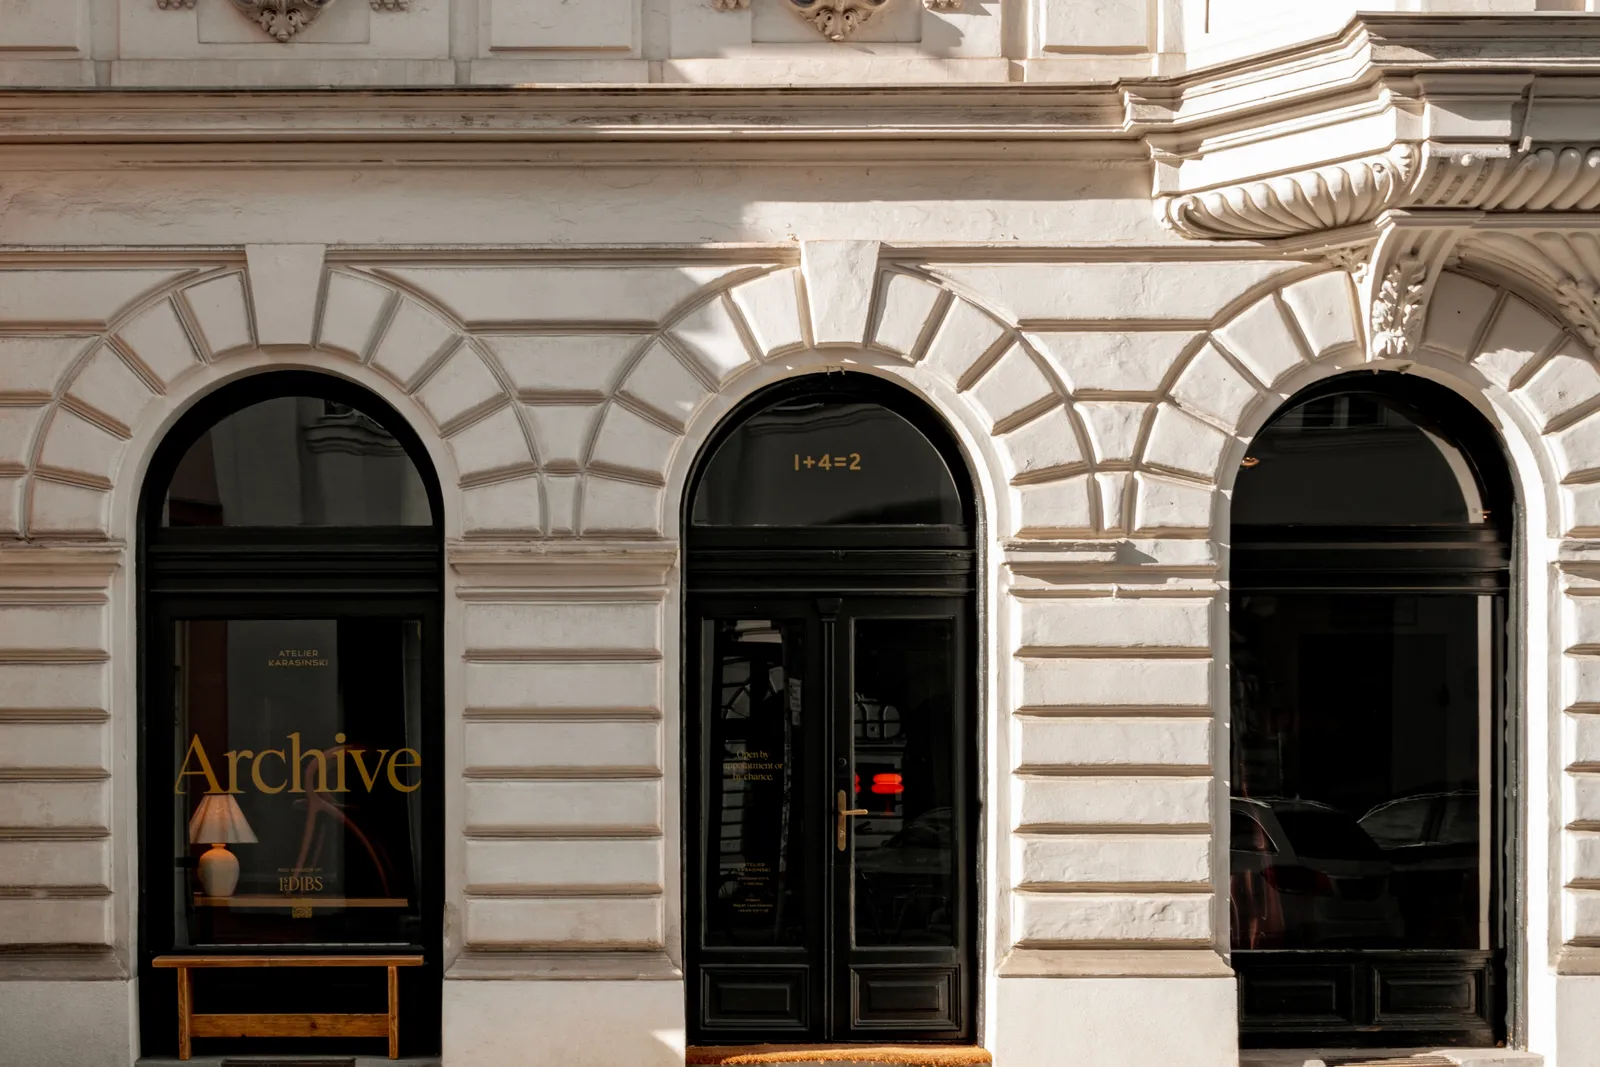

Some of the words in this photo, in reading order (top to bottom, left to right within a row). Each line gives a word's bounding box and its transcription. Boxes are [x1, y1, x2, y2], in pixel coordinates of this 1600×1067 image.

[278, 649, 319, 657] ATELIER
[268, 659, 328, 667] KARASINSKI
[736, 751, 759, 761] Open
[760, 750, 769, 760] by
[174, 731, 422, 795] Archive
